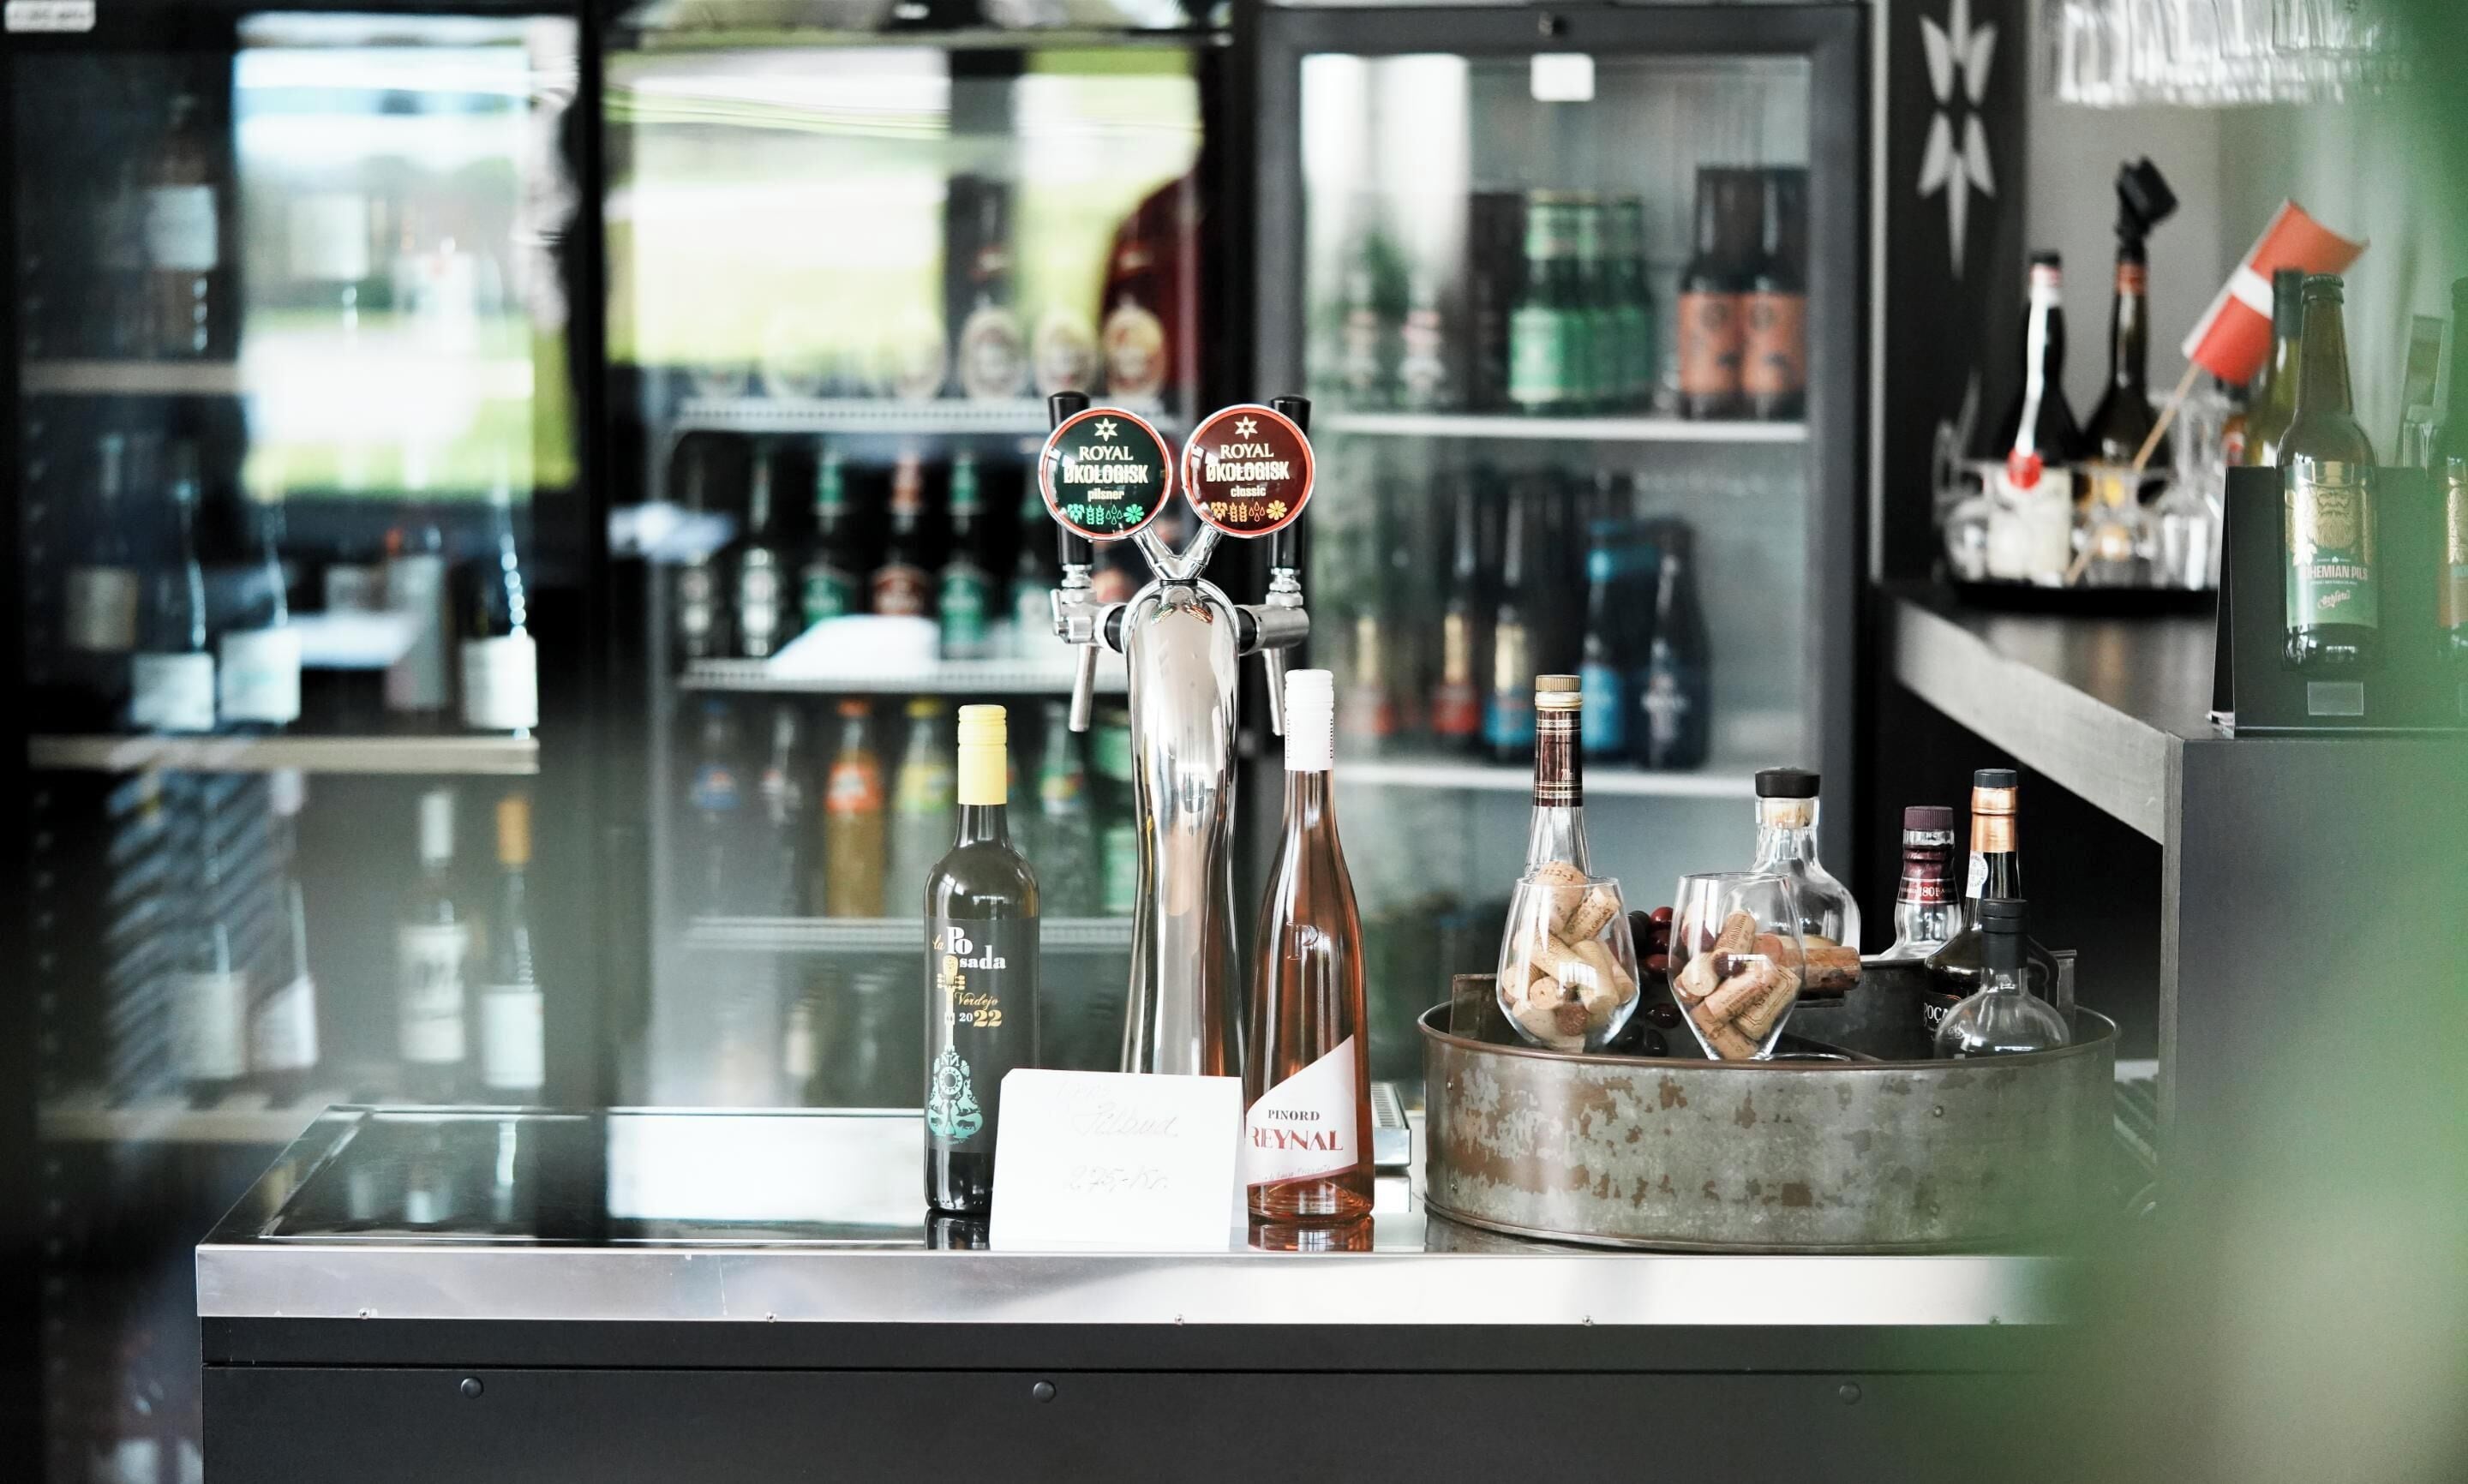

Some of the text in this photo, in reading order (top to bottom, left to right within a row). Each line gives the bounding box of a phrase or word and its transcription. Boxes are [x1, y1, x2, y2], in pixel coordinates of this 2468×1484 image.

[1078, 446, 1134, 461] ROYAL
[1219, 443, 1274, 459] ROYAL
[1063, 464, 1148, 484] ØKOLOGISK
[1206, 461, 1291, 482] ØKOLOGISK
[1087, 488, 1125, 501] pilsner
[1230, 486, 1267, 497] classic
[2351, 566, 2368, 581] PILS
[932, 934, 945, 950] la
[955, 992, 999, 1011] Verdejo
[959, 1009, 1002, 1027] 2022
[1268, 1110, 1320, 1121] PINORD
[1251, 1127, 1344, 1151] REYNAL
